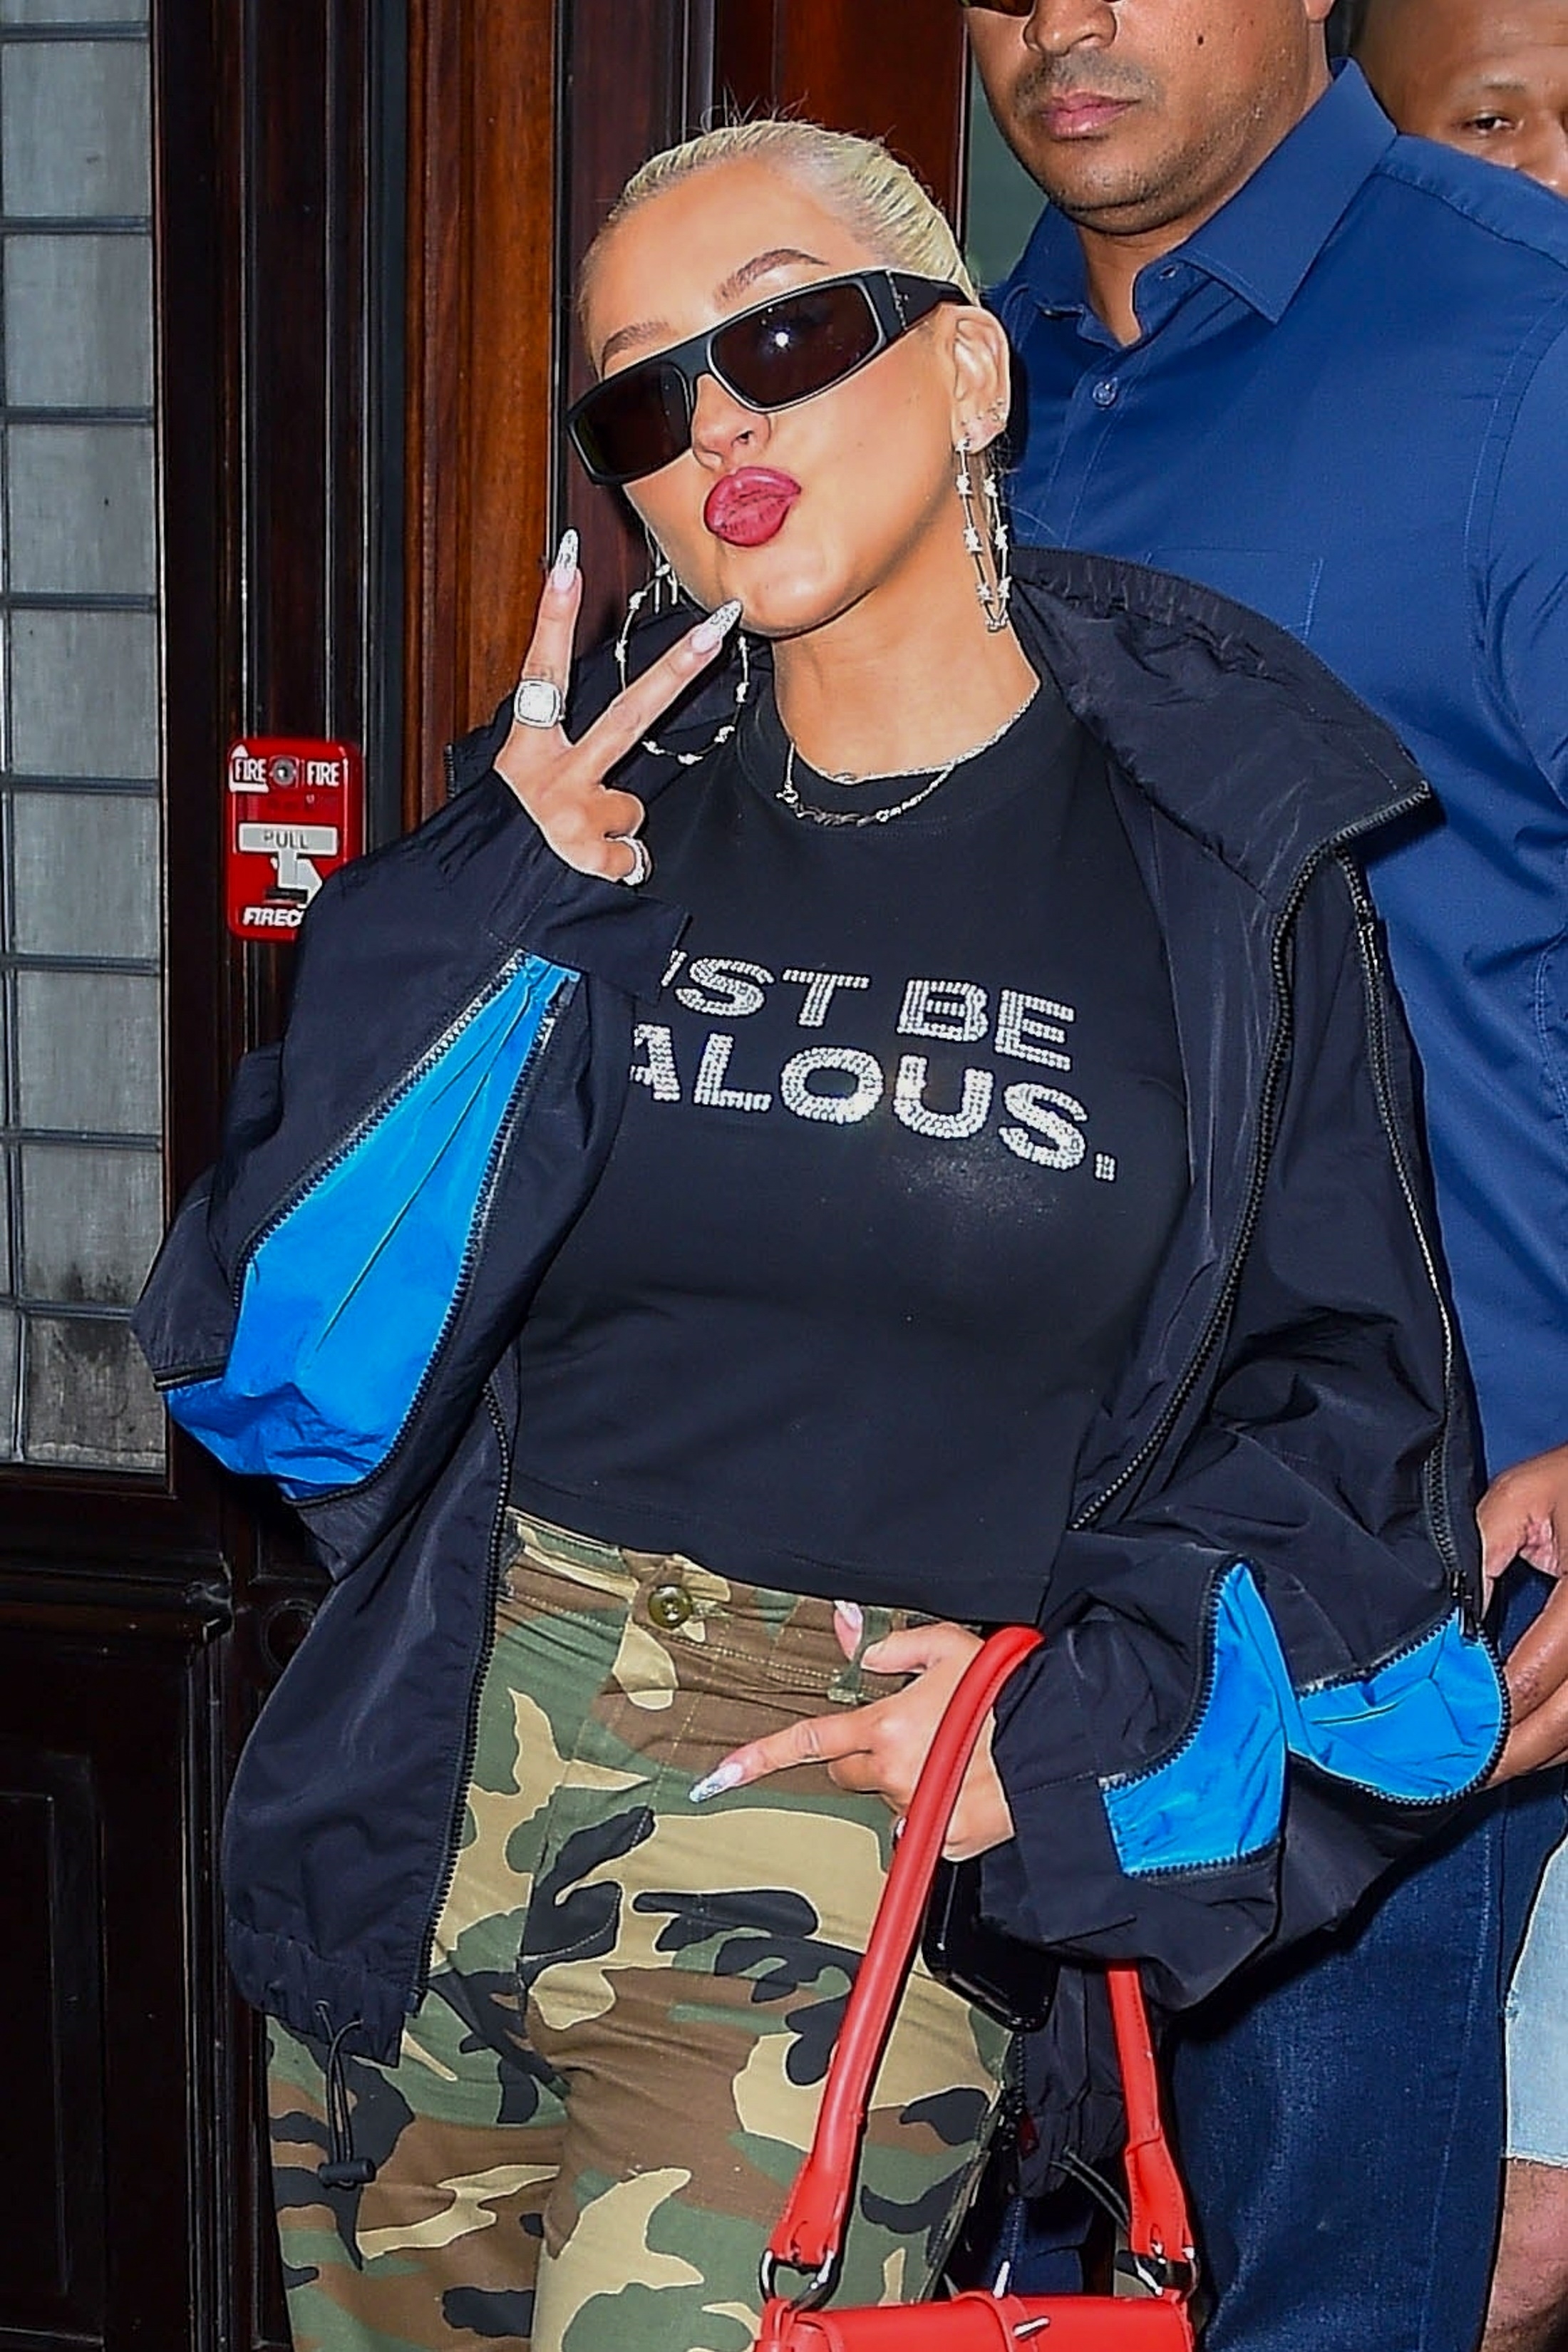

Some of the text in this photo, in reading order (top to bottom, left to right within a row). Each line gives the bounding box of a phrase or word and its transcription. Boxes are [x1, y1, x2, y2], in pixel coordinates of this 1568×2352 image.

[235, 758, 267, 783] FIRE
[307, 761, 340, 787] FIRE
[263, 829, 309, 850] PULL
[242, 907, 304, 927] FIREC
[895, 979, 1076, 1071] BE
